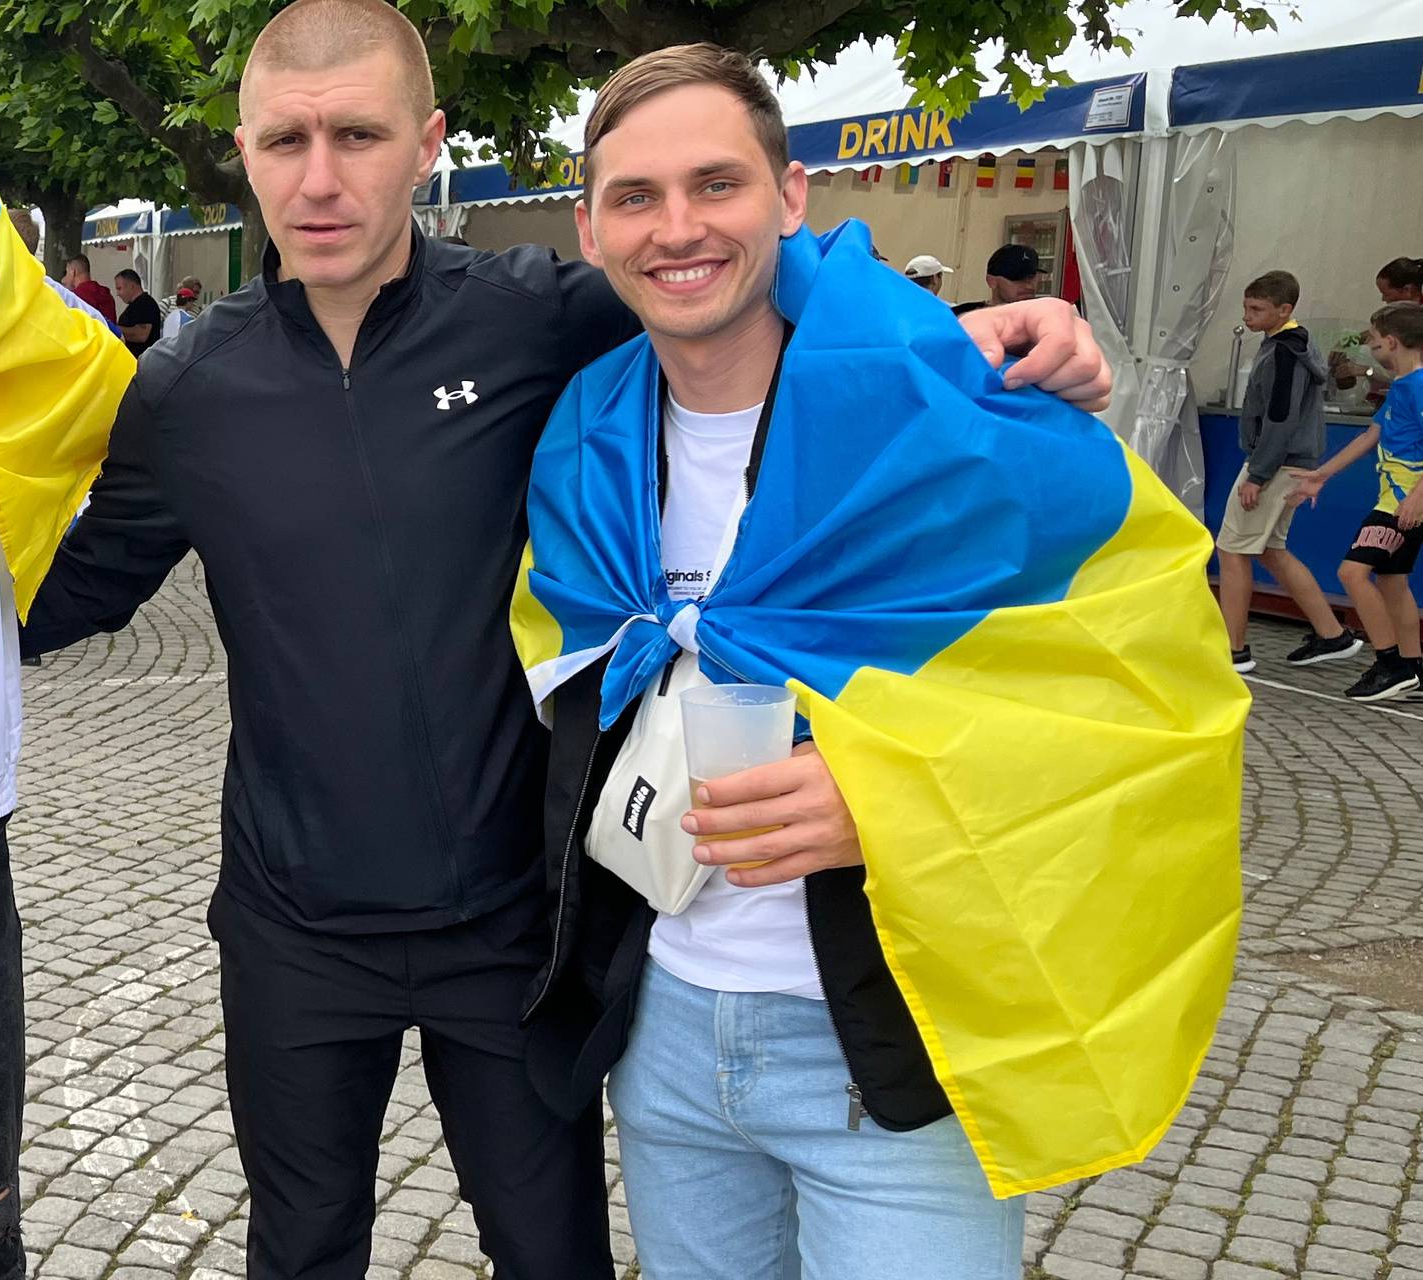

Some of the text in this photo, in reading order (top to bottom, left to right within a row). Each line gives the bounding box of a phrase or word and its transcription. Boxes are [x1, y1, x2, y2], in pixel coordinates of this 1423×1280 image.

[837, 110, 954, 160] DRINK
[201, 203, 227, 225] OOD
[665, 569, 704, 585] iginals
